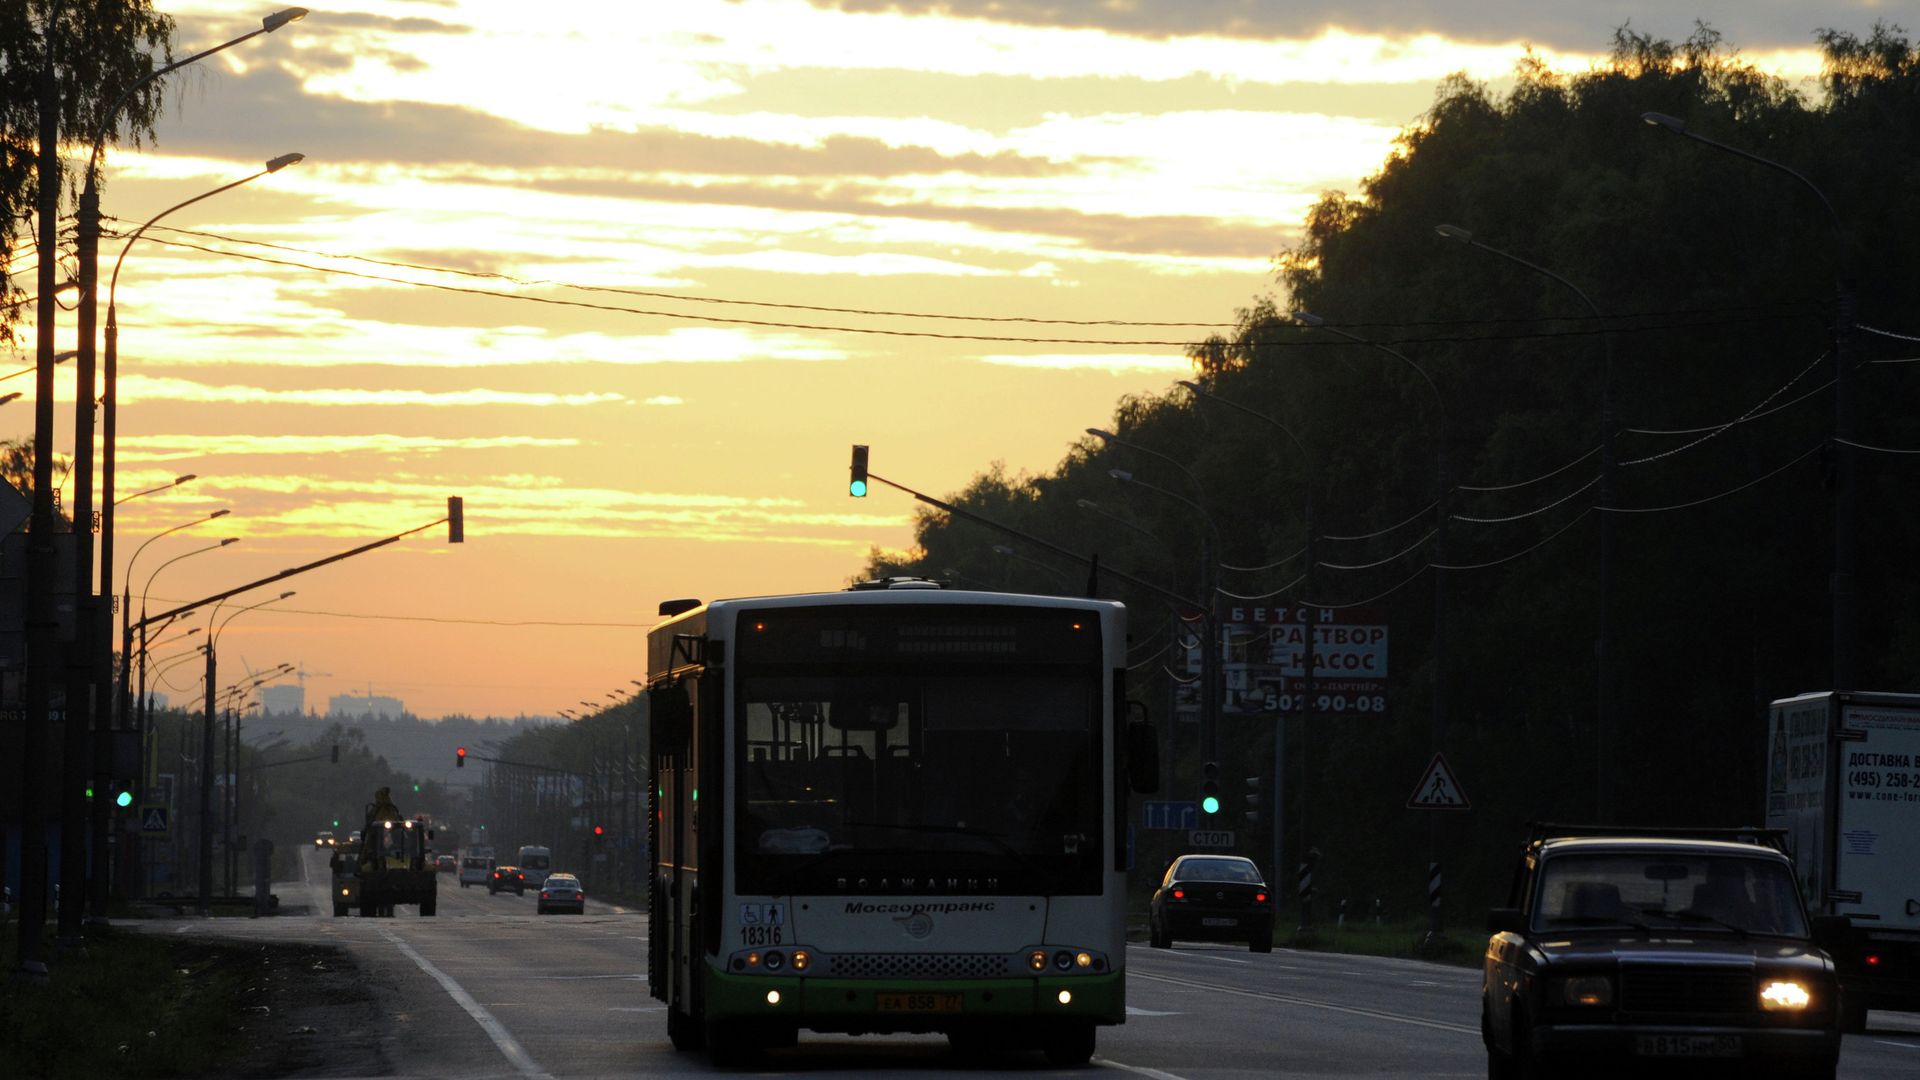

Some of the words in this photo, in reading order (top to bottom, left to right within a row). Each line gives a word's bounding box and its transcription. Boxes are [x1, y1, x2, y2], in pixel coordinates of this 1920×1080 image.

[1231, 608, 1334, 623] БЕТОН
[1292, 653, 1375, 670] НАСОС
[1849, 752, 1910, 768] ДОСТАВКА
[1848, 771, 1881, 788] (495)
[1886, 773, 1920, 788] 258-2
[1848, 791, 1920, 802] www.cone-for
[1193, 832, 1229, 845] СТОП
[845, 902, 996, 915] Мосгортранс
[741, 926, 782, 945] 18316
[908, 995, 936, 1009] 858
